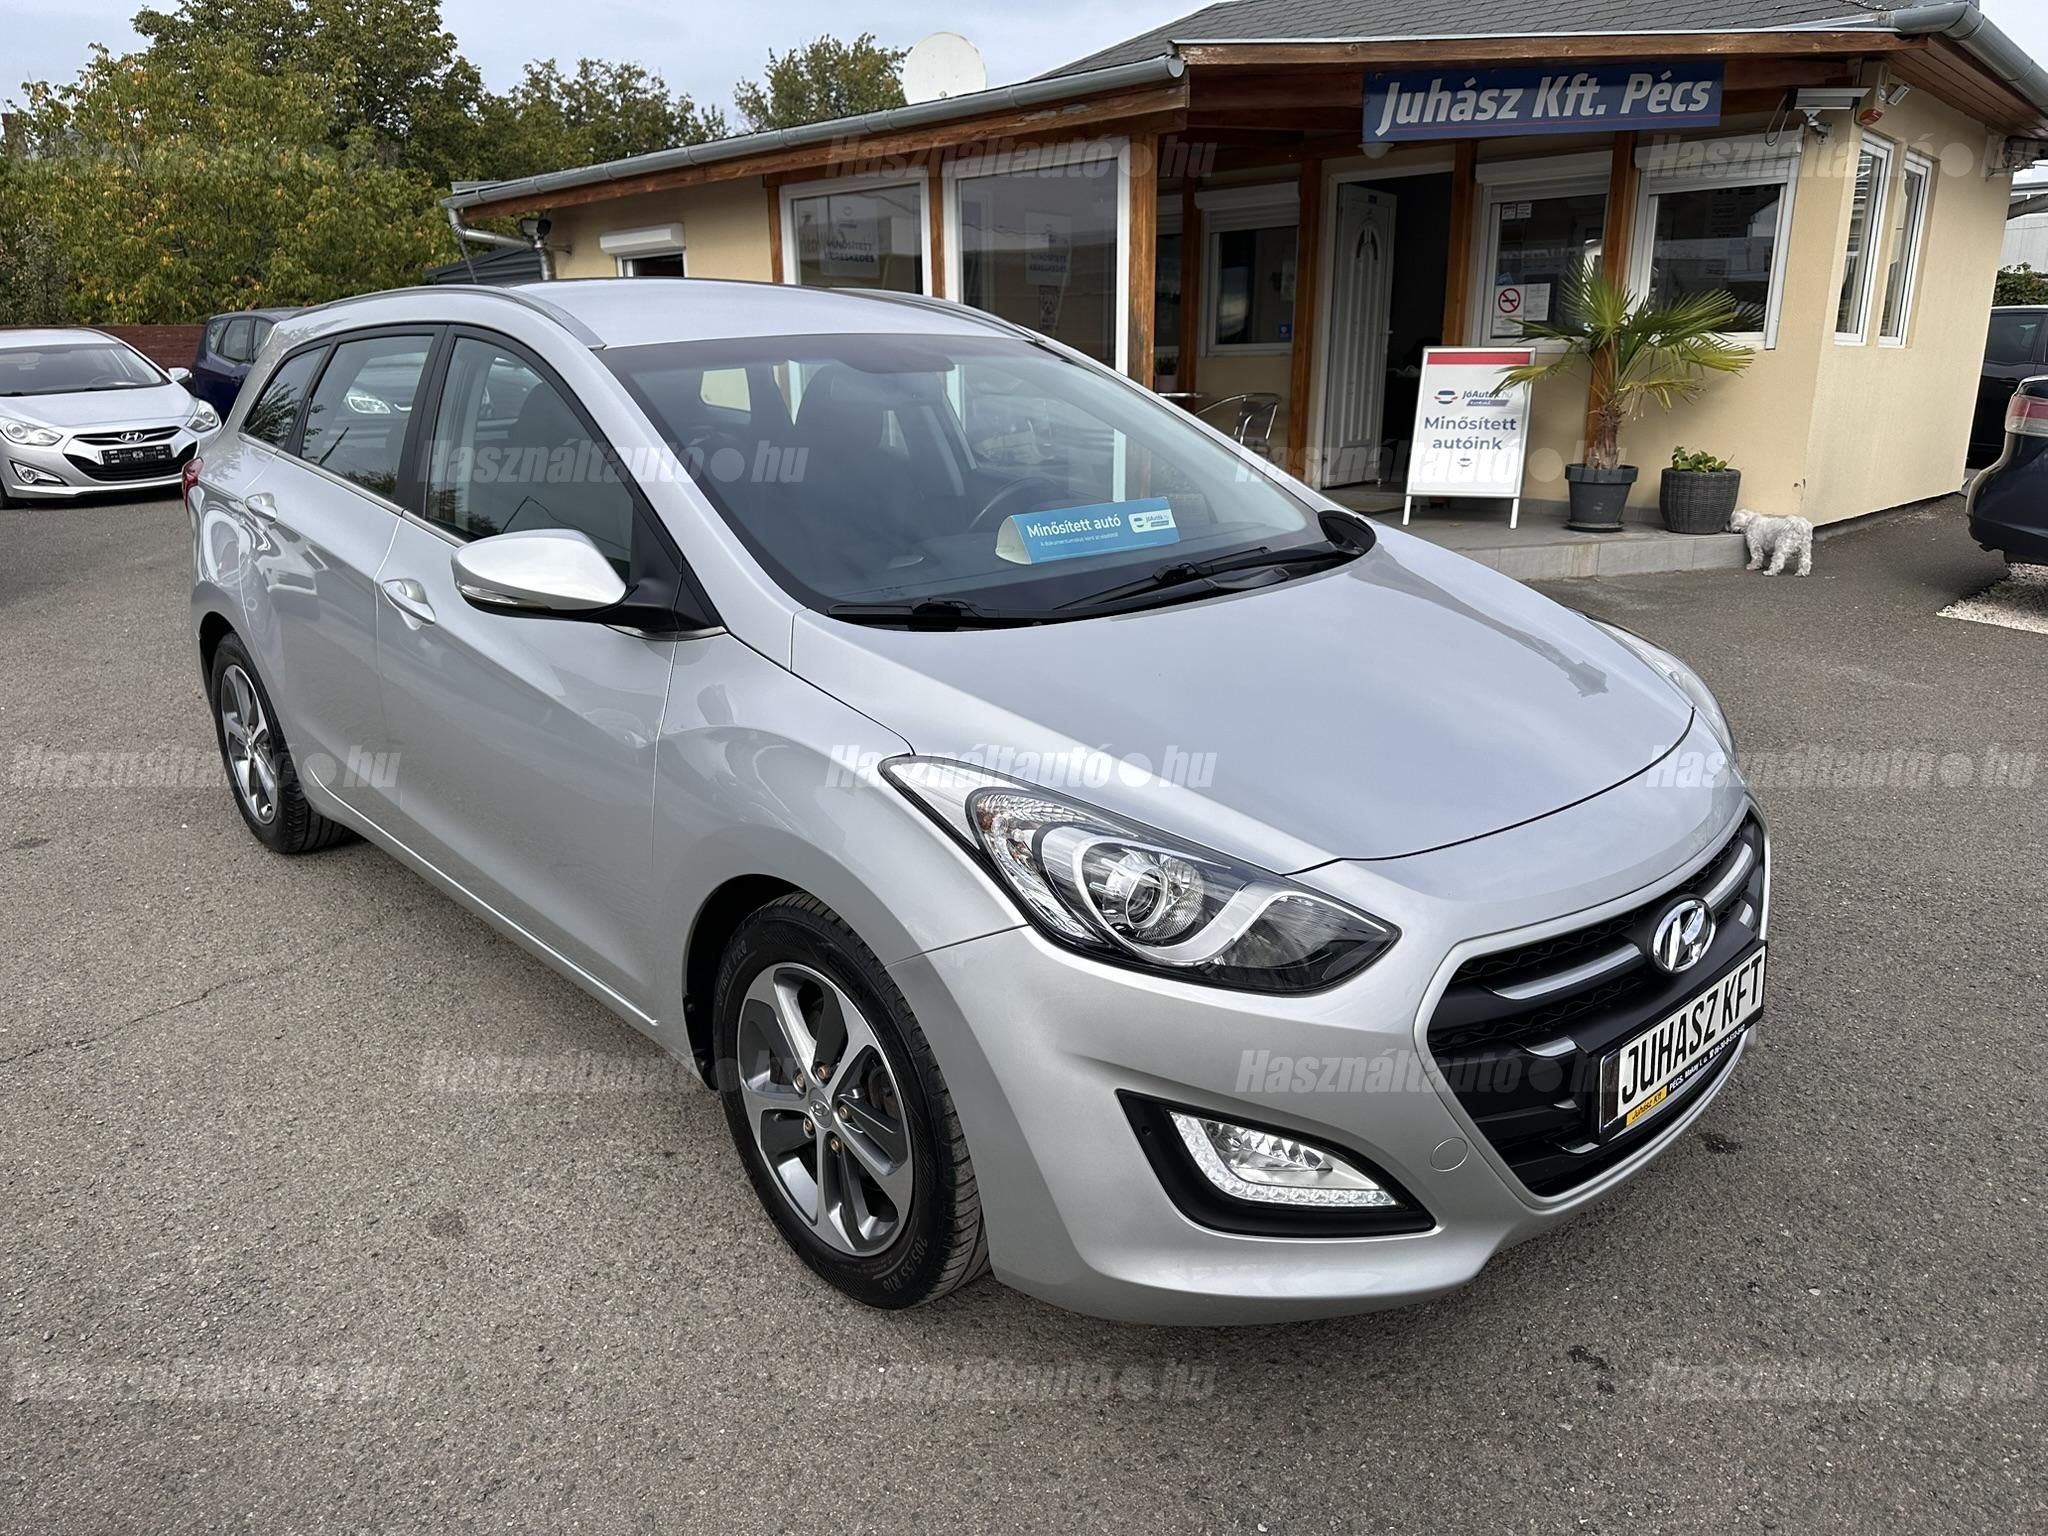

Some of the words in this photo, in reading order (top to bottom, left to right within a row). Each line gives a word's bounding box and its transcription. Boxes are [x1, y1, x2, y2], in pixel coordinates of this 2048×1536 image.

[1375, 77, 1523, 136] Juhász
[1532, 73, 1606, 118] Kft.
[1619, 70, 1713, 114] Pécs
[1424, 416, 1517, 431] Minősített
[1432, 436, 1502, 450] autóink
[1026, 518, 1092, 538] Minősített
[1094, 513, 1122, 531] autó
[1621, 988, 1720, 1104] JUHASZ
[1720, 954, 1763, 1032] KFT
